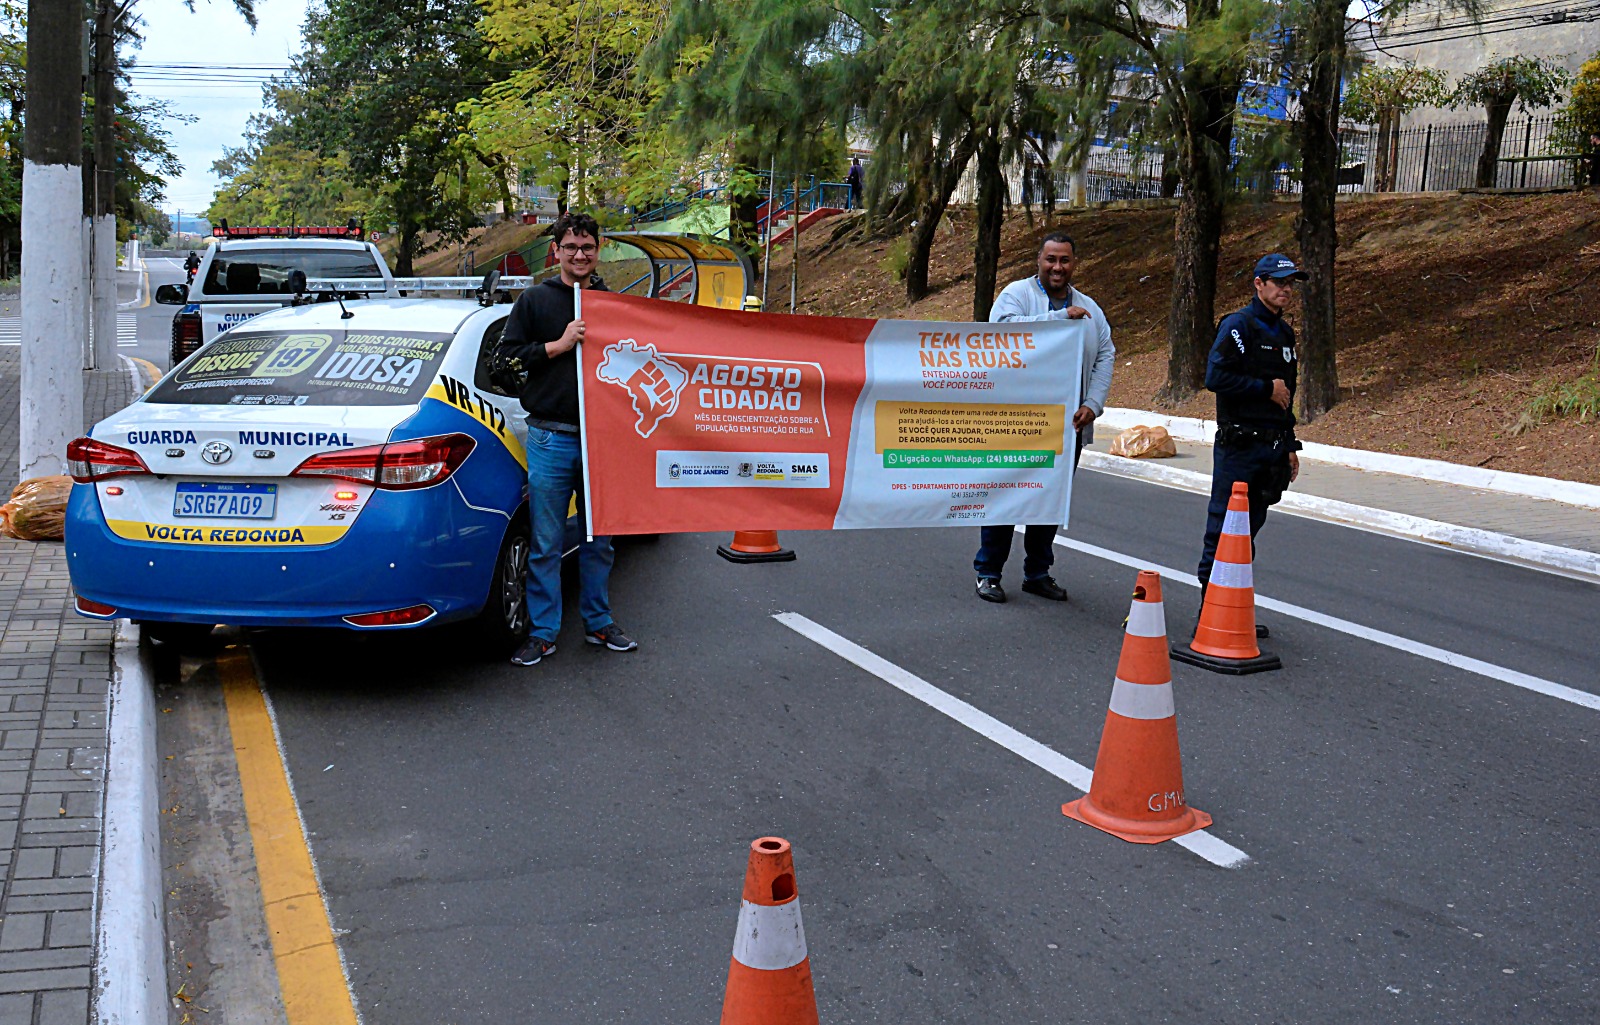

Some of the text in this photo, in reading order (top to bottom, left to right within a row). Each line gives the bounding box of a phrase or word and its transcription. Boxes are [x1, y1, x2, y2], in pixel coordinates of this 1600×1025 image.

[225, 313, 260, 322] GUAR
[344, 335, 444, 352] TODOS CONTRA A
[918, 332, 1036, 349] TEM GENTE
[267, 348, 320, 367] 197
[335, 343, 436, 360] VIOLÊNCIA A PESSOA
[919, 351, 1026, 368] NAS RUAS.
[187, 351, 265, 374] DISQUE
[314, 352, 423, 386] IDOSA
[690, 363, 801, 388] AGOSTO
[922, 370, 960, 379] ENTENDA
[971, 371, 988, 380] QUE
[340, 382, 376, 391] PROTEÇÃO
[386, 385, 408, 394] IDOSO
[923, 380, 994, 390] VOCÊ PODE FAZER!
[439, 374, 505, 438] VR 772
[699, 386, 801, 410] CIDADÃO
[694, 413, 710, 421] MÊS
[722, 414, 788, 424] CONSCIENTIZAÇÃO
[915, 418, 949, 426] ajudá-los
[995, 419, 1023, 427] projetos
[696, 424, 738, 433] POPULAÇÃO
[752, 426, 786, 434] SITUAÇÃO
[128, 431, 354, 446] GUARDA MUNICIPAL
[900, 455, 930, 465] Ligação
[944, 455, 984, 464] WhatsApp:
[986, 455, 1001, 463] (24)
[792, 465, 818, 473] SMAS
[969, 482, 998, 490] PROTEÇÃO
[183, 494, 262, 515] SRG7A09
[320, 504, 360, 512] YARIS
[145, 525, 304, 542] VOLTA REDONDA
[1148, 790, 1185, 812] GMV
